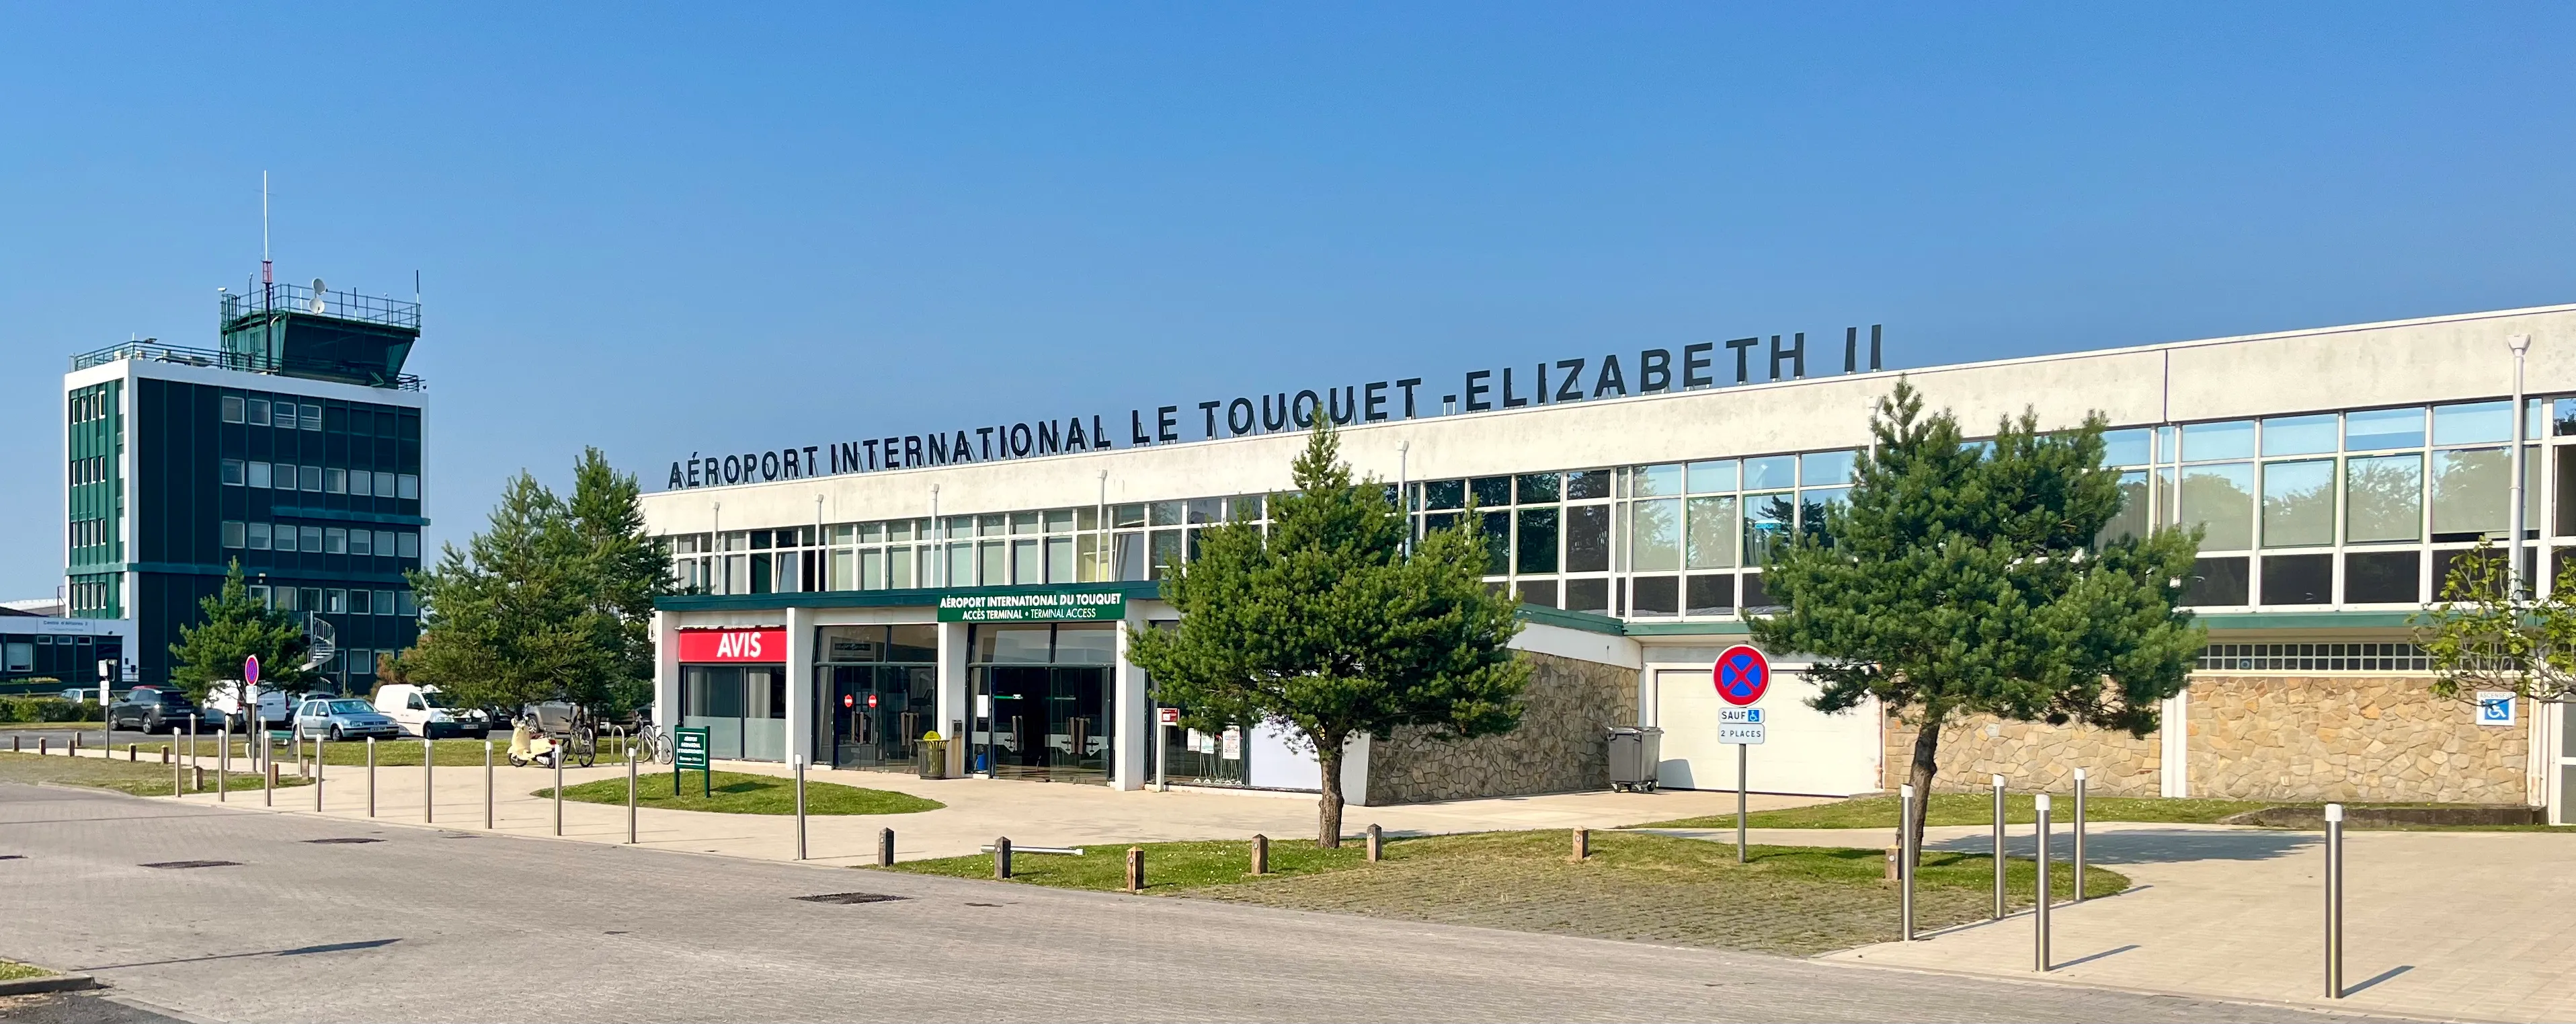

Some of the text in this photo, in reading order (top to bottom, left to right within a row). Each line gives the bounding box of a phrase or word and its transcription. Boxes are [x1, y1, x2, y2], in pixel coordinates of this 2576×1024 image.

[668, 446, 818, 489] AÉROPORT
[830, 414, 1112, 476] INTERNATIONAL
[1132, 405, 1178, 446] LE
[1199, 377, 1422, 441] TOUQUET
[1844, 324, 1882, 372] II
[940, 593, 1122, 608] AÉROPORT INTERNATIONAL DU TOUQUET
[962, 608, 1096, 620] ACCÈS TERMINAL TERMINAL ACCESS
[717, 631, 762, 658] AVIS
[1721, 711, 1746, 719] SAUF
